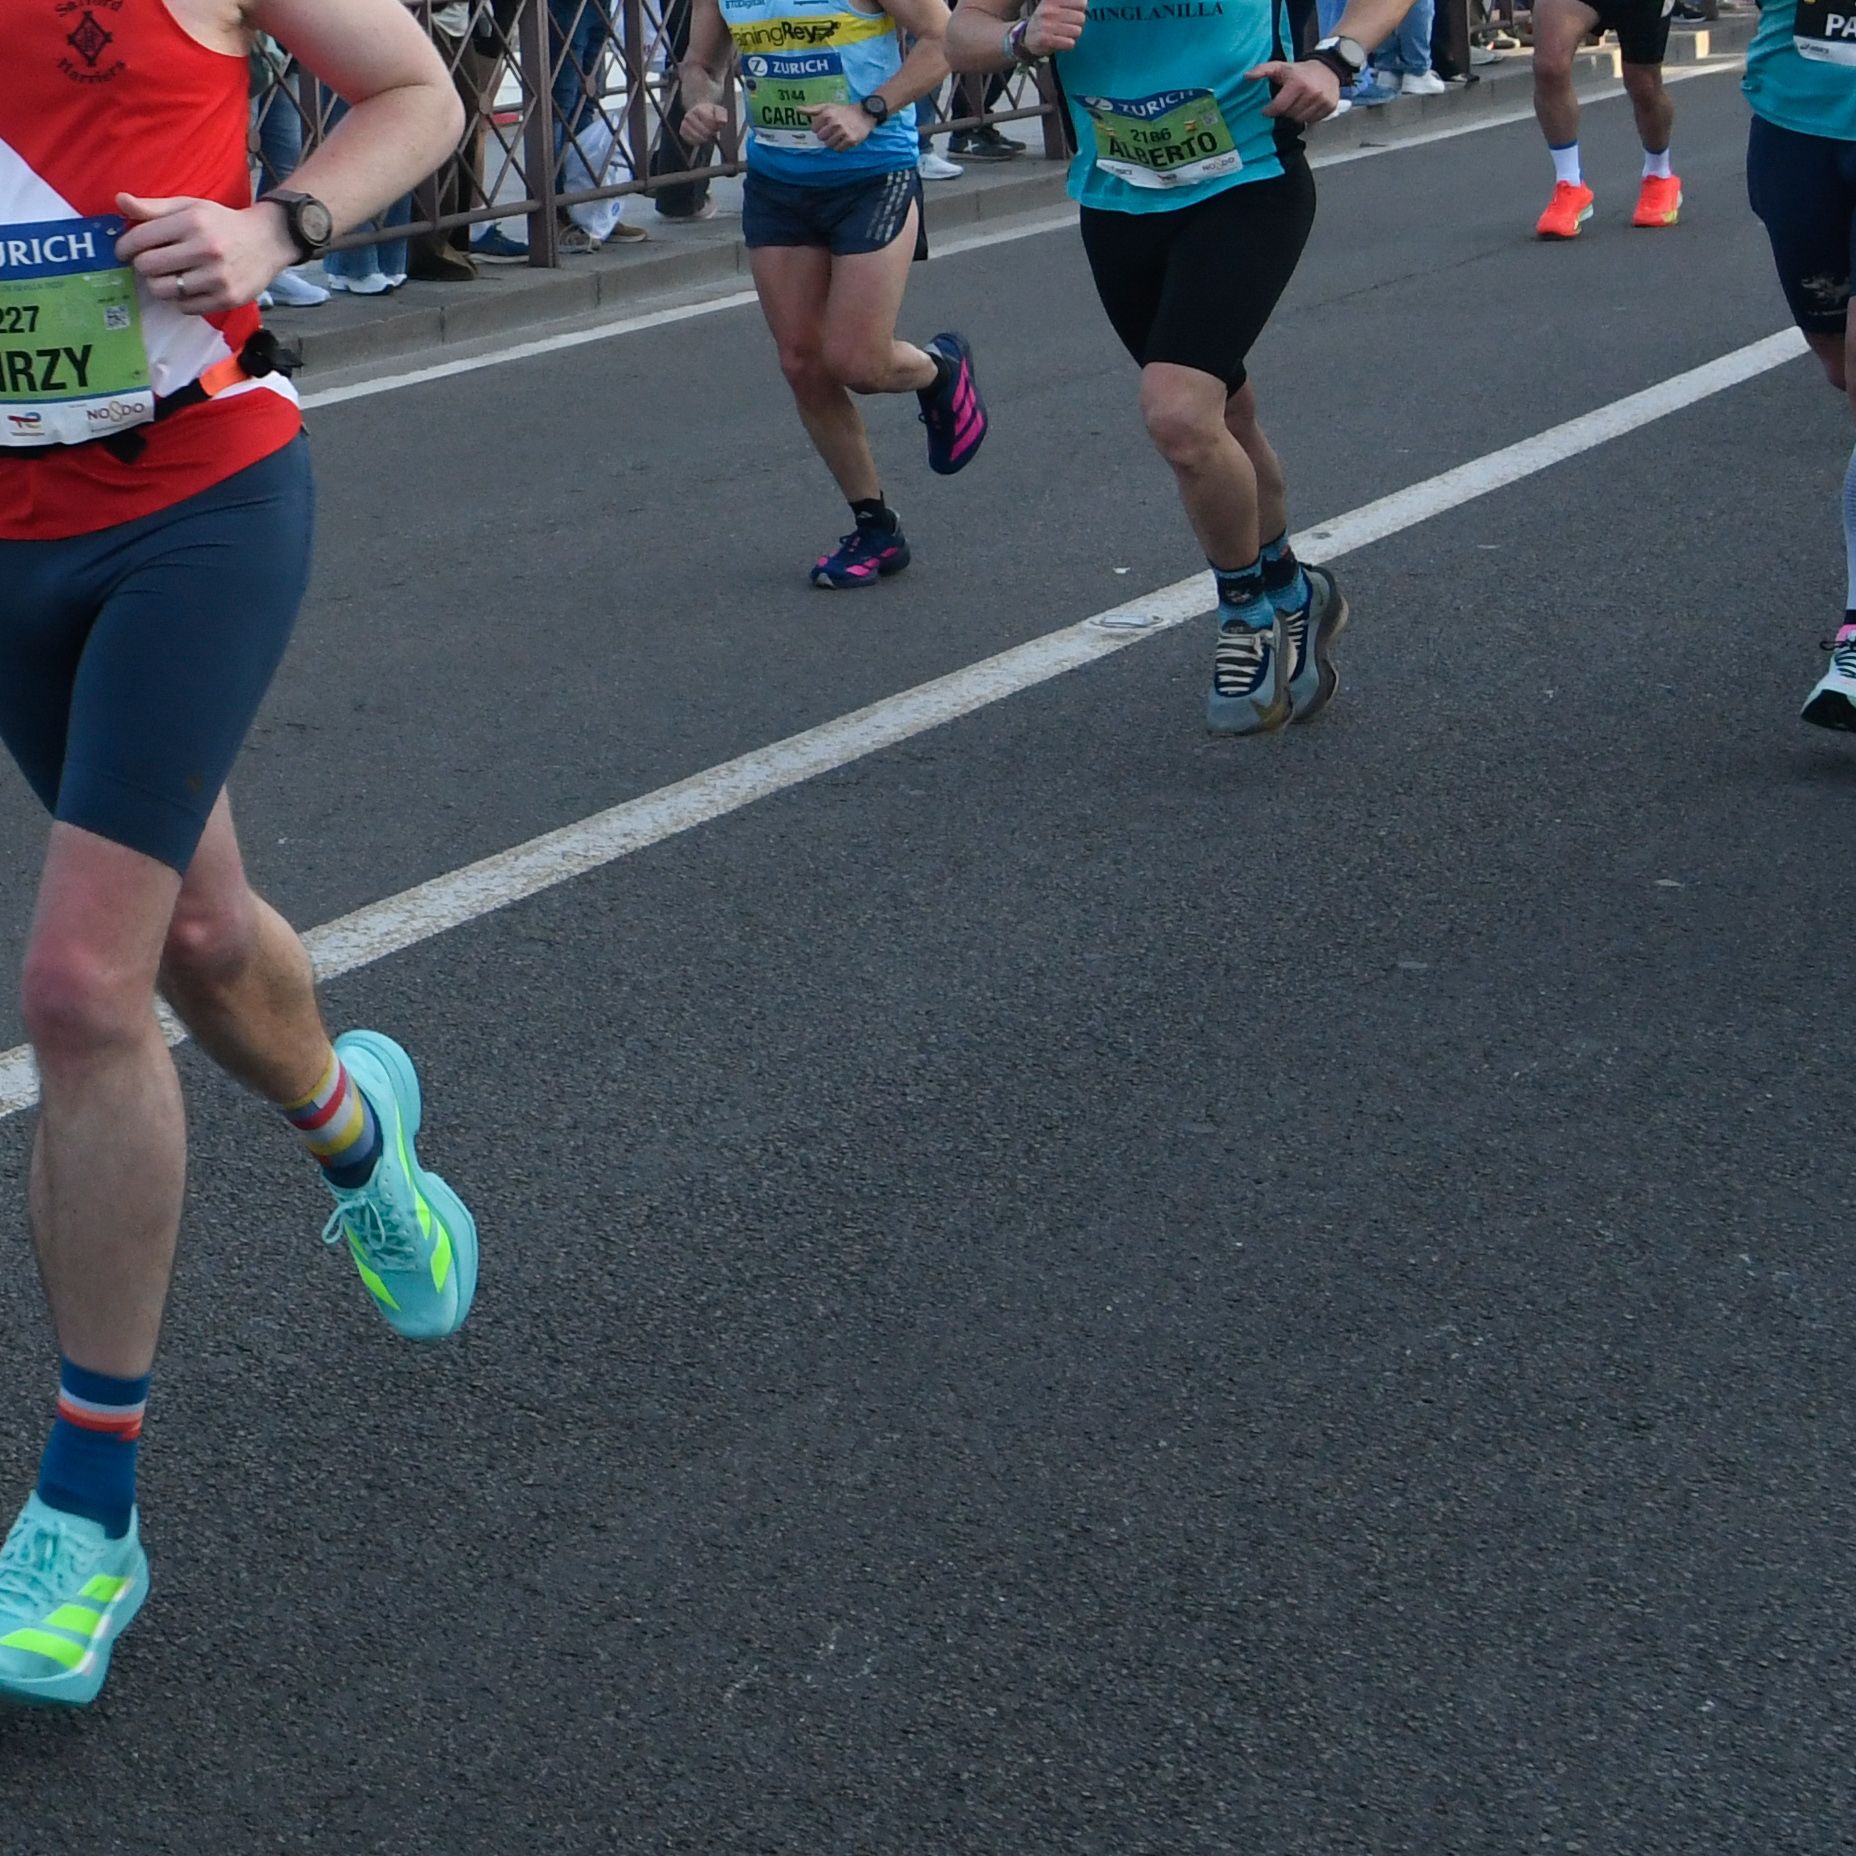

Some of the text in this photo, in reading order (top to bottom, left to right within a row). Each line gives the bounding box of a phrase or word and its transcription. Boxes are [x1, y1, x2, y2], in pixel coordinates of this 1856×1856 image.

[1085, 0, 1224, 22] MINGLANILLA
[772, 59, 829, 75] ZURICH
[762, 106, 813, 126] CARL
[1109, 131, 1218, 168] ALBERTO
